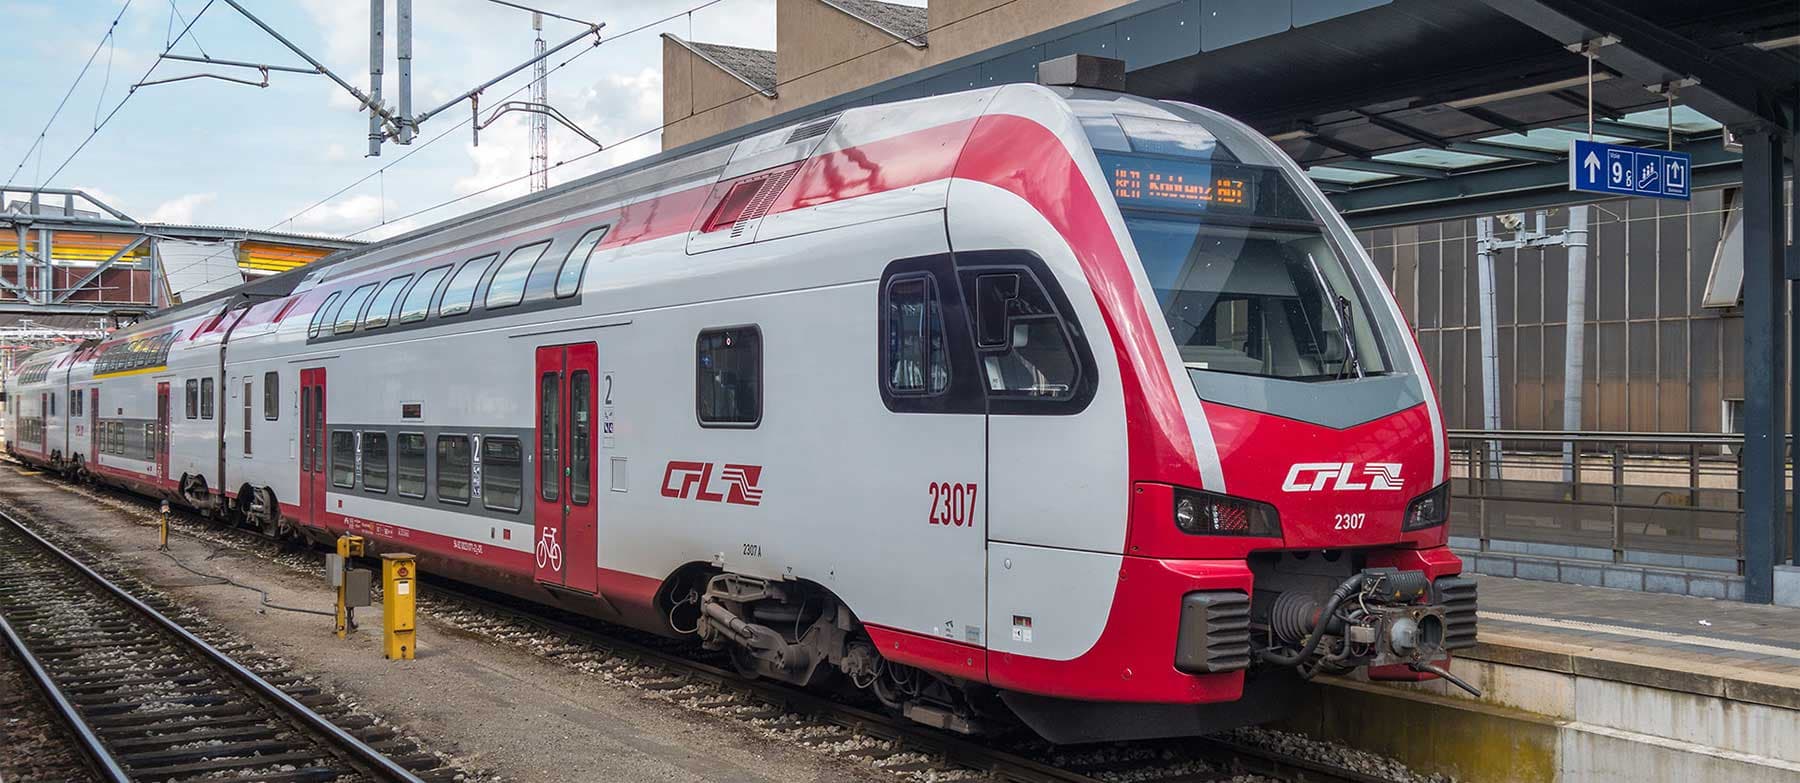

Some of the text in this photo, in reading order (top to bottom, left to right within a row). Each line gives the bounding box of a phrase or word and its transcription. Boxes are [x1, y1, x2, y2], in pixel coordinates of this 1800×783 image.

[1612, 161, 1622, 184] 9
[605, 374, 613, 405] 2
[356, 431, 361, 453] 2
[473, 436, 480, 462] 2
[1281, 462, 1368, 492] CFL
[928, 481, 978, 528] 2307
[1334, 513, 1366, 530] 2307
